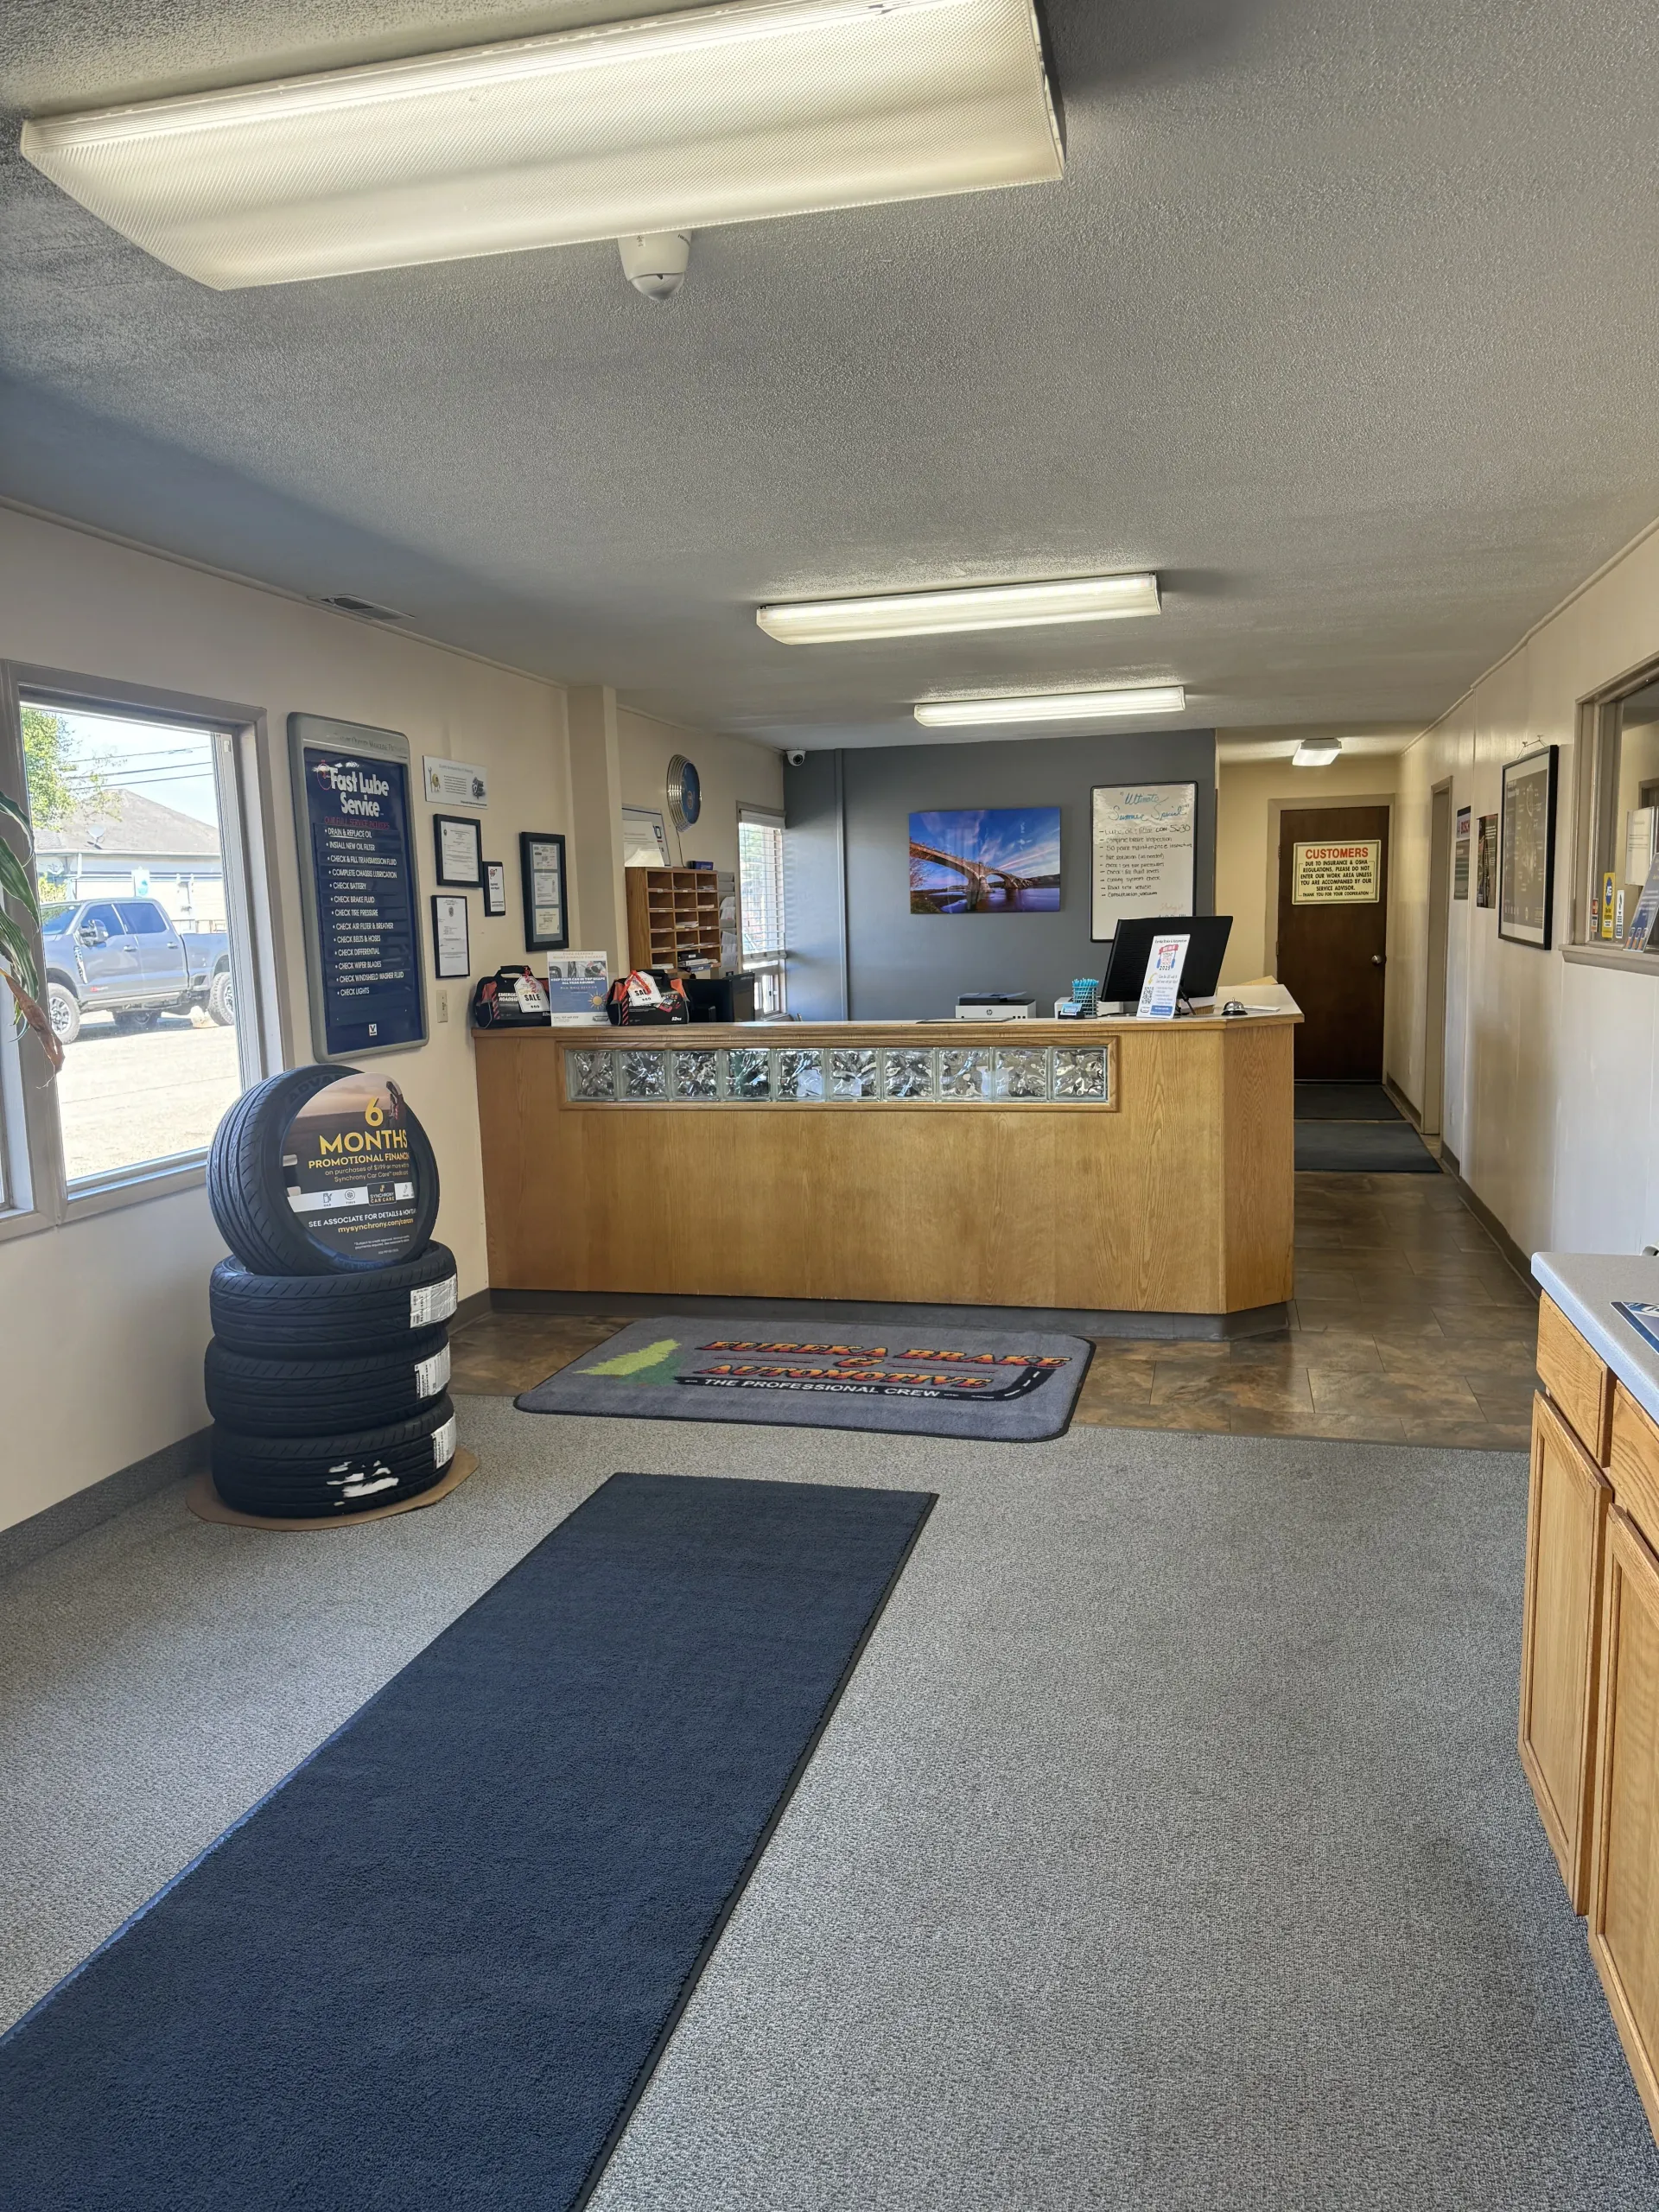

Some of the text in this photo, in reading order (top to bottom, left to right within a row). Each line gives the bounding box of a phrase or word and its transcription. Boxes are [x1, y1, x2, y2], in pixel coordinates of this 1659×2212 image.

[329, 767, 390, 796] Fast Lube
[340, 791, 380, 817] Service
[1306, 847, 1369, 860] CUSTOMERS
[332, 868, 356, 877] COMPLETE
[355, 869, 373, 878] CHASSIS
[354, 947, 380, 956] DIFFERENTIAL
[355, 973, 378, 982] WINDSHIELD
[365, 1097, 384, 1127] 6
[319, 1129, 408, 1155] MONTHS
[308, 1154, 384, 1169] PROMOTIONAL
[334, 1166, 366, 1175] purchases
[334, 1174, 366, 1183] Synchrony
[322, 1215, 364, 1226] ASSOCIATE
[378, 1210, 399, 1219] DETAILS
[695, 1340, 1072, 1368] EUREKA BRAKE
[833, 1357, 885, 1369] &
[693, 1364, 993, 1389] AUTOMOTIVE
[704, 1378, 940, 1397] THE PROFESSIONAL CREW
